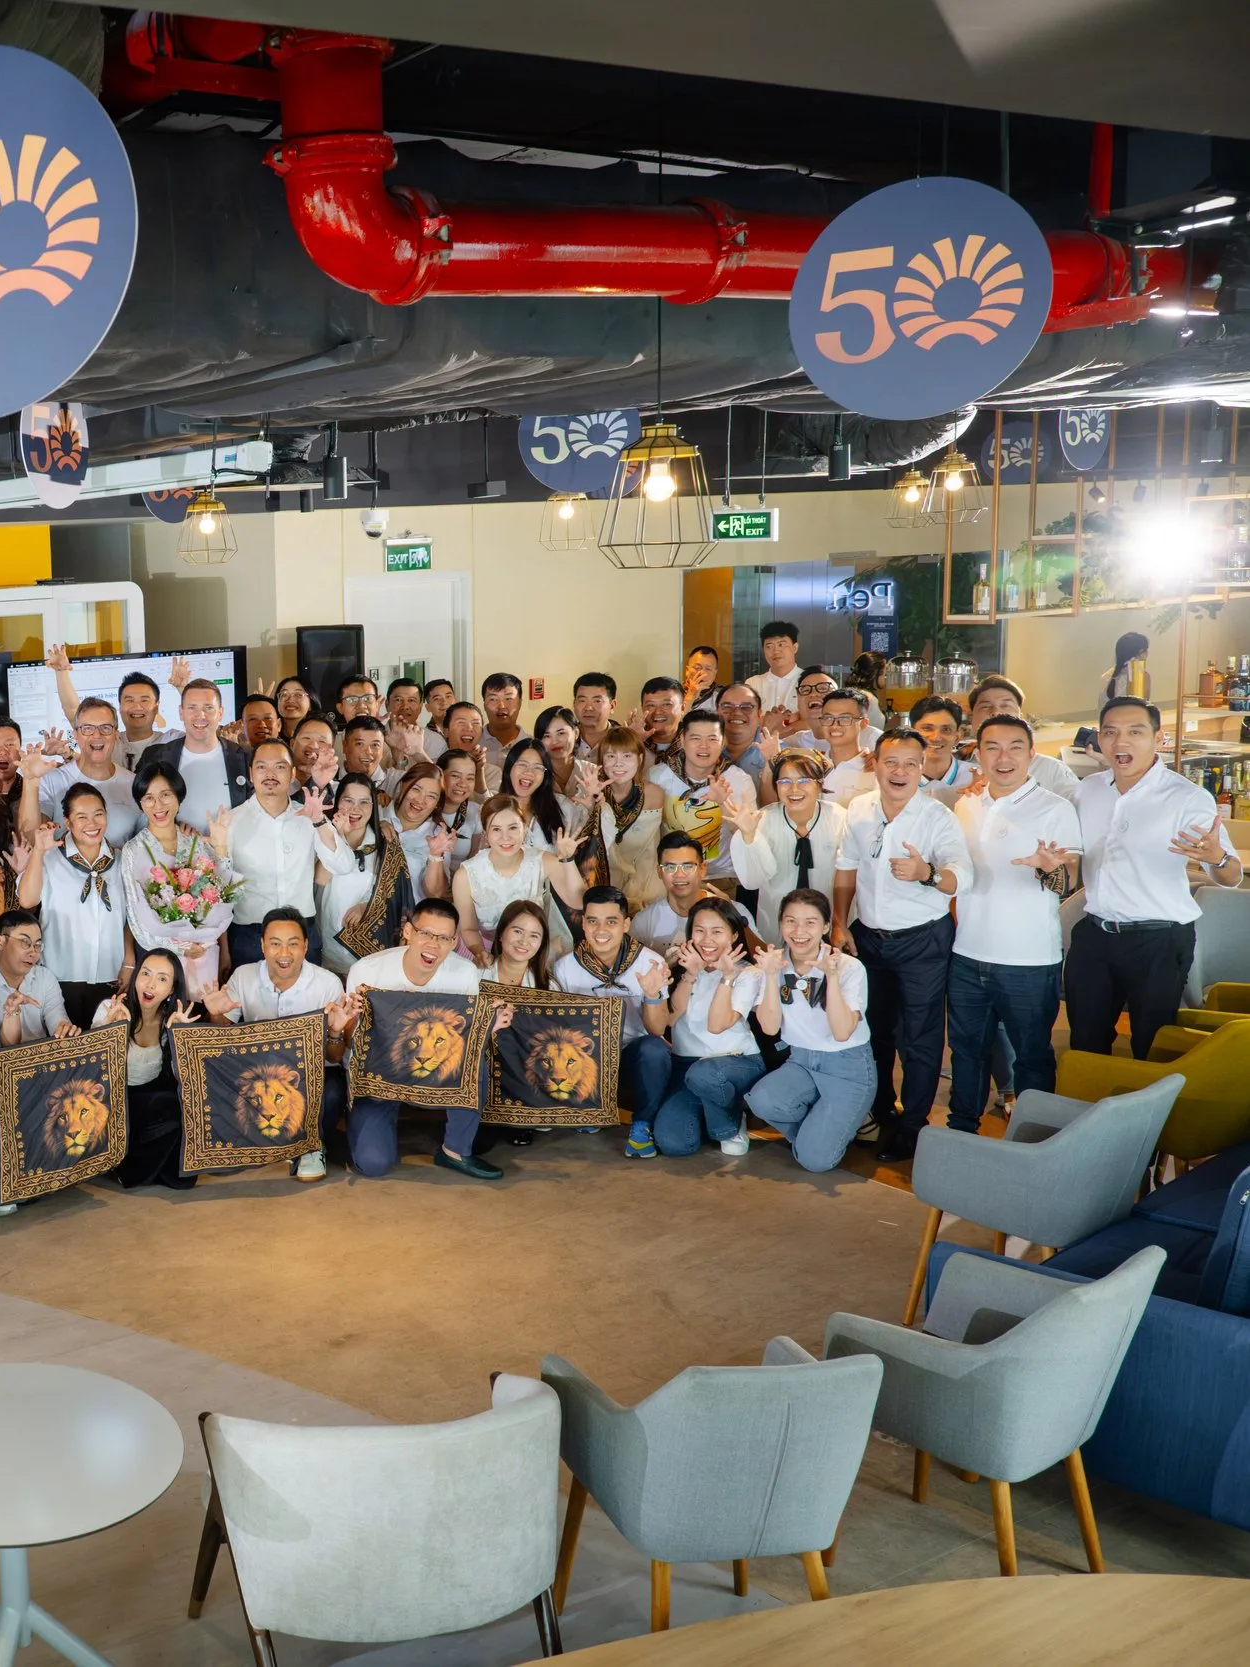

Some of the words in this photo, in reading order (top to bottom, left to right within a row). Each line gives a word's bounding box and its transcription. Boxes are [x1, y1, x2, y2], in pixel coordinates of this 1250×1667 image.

[814, 234, 1024, 365] 50
[745, 528, 764, 536] EXIT
[388, 553, 409, 564] EXIT
